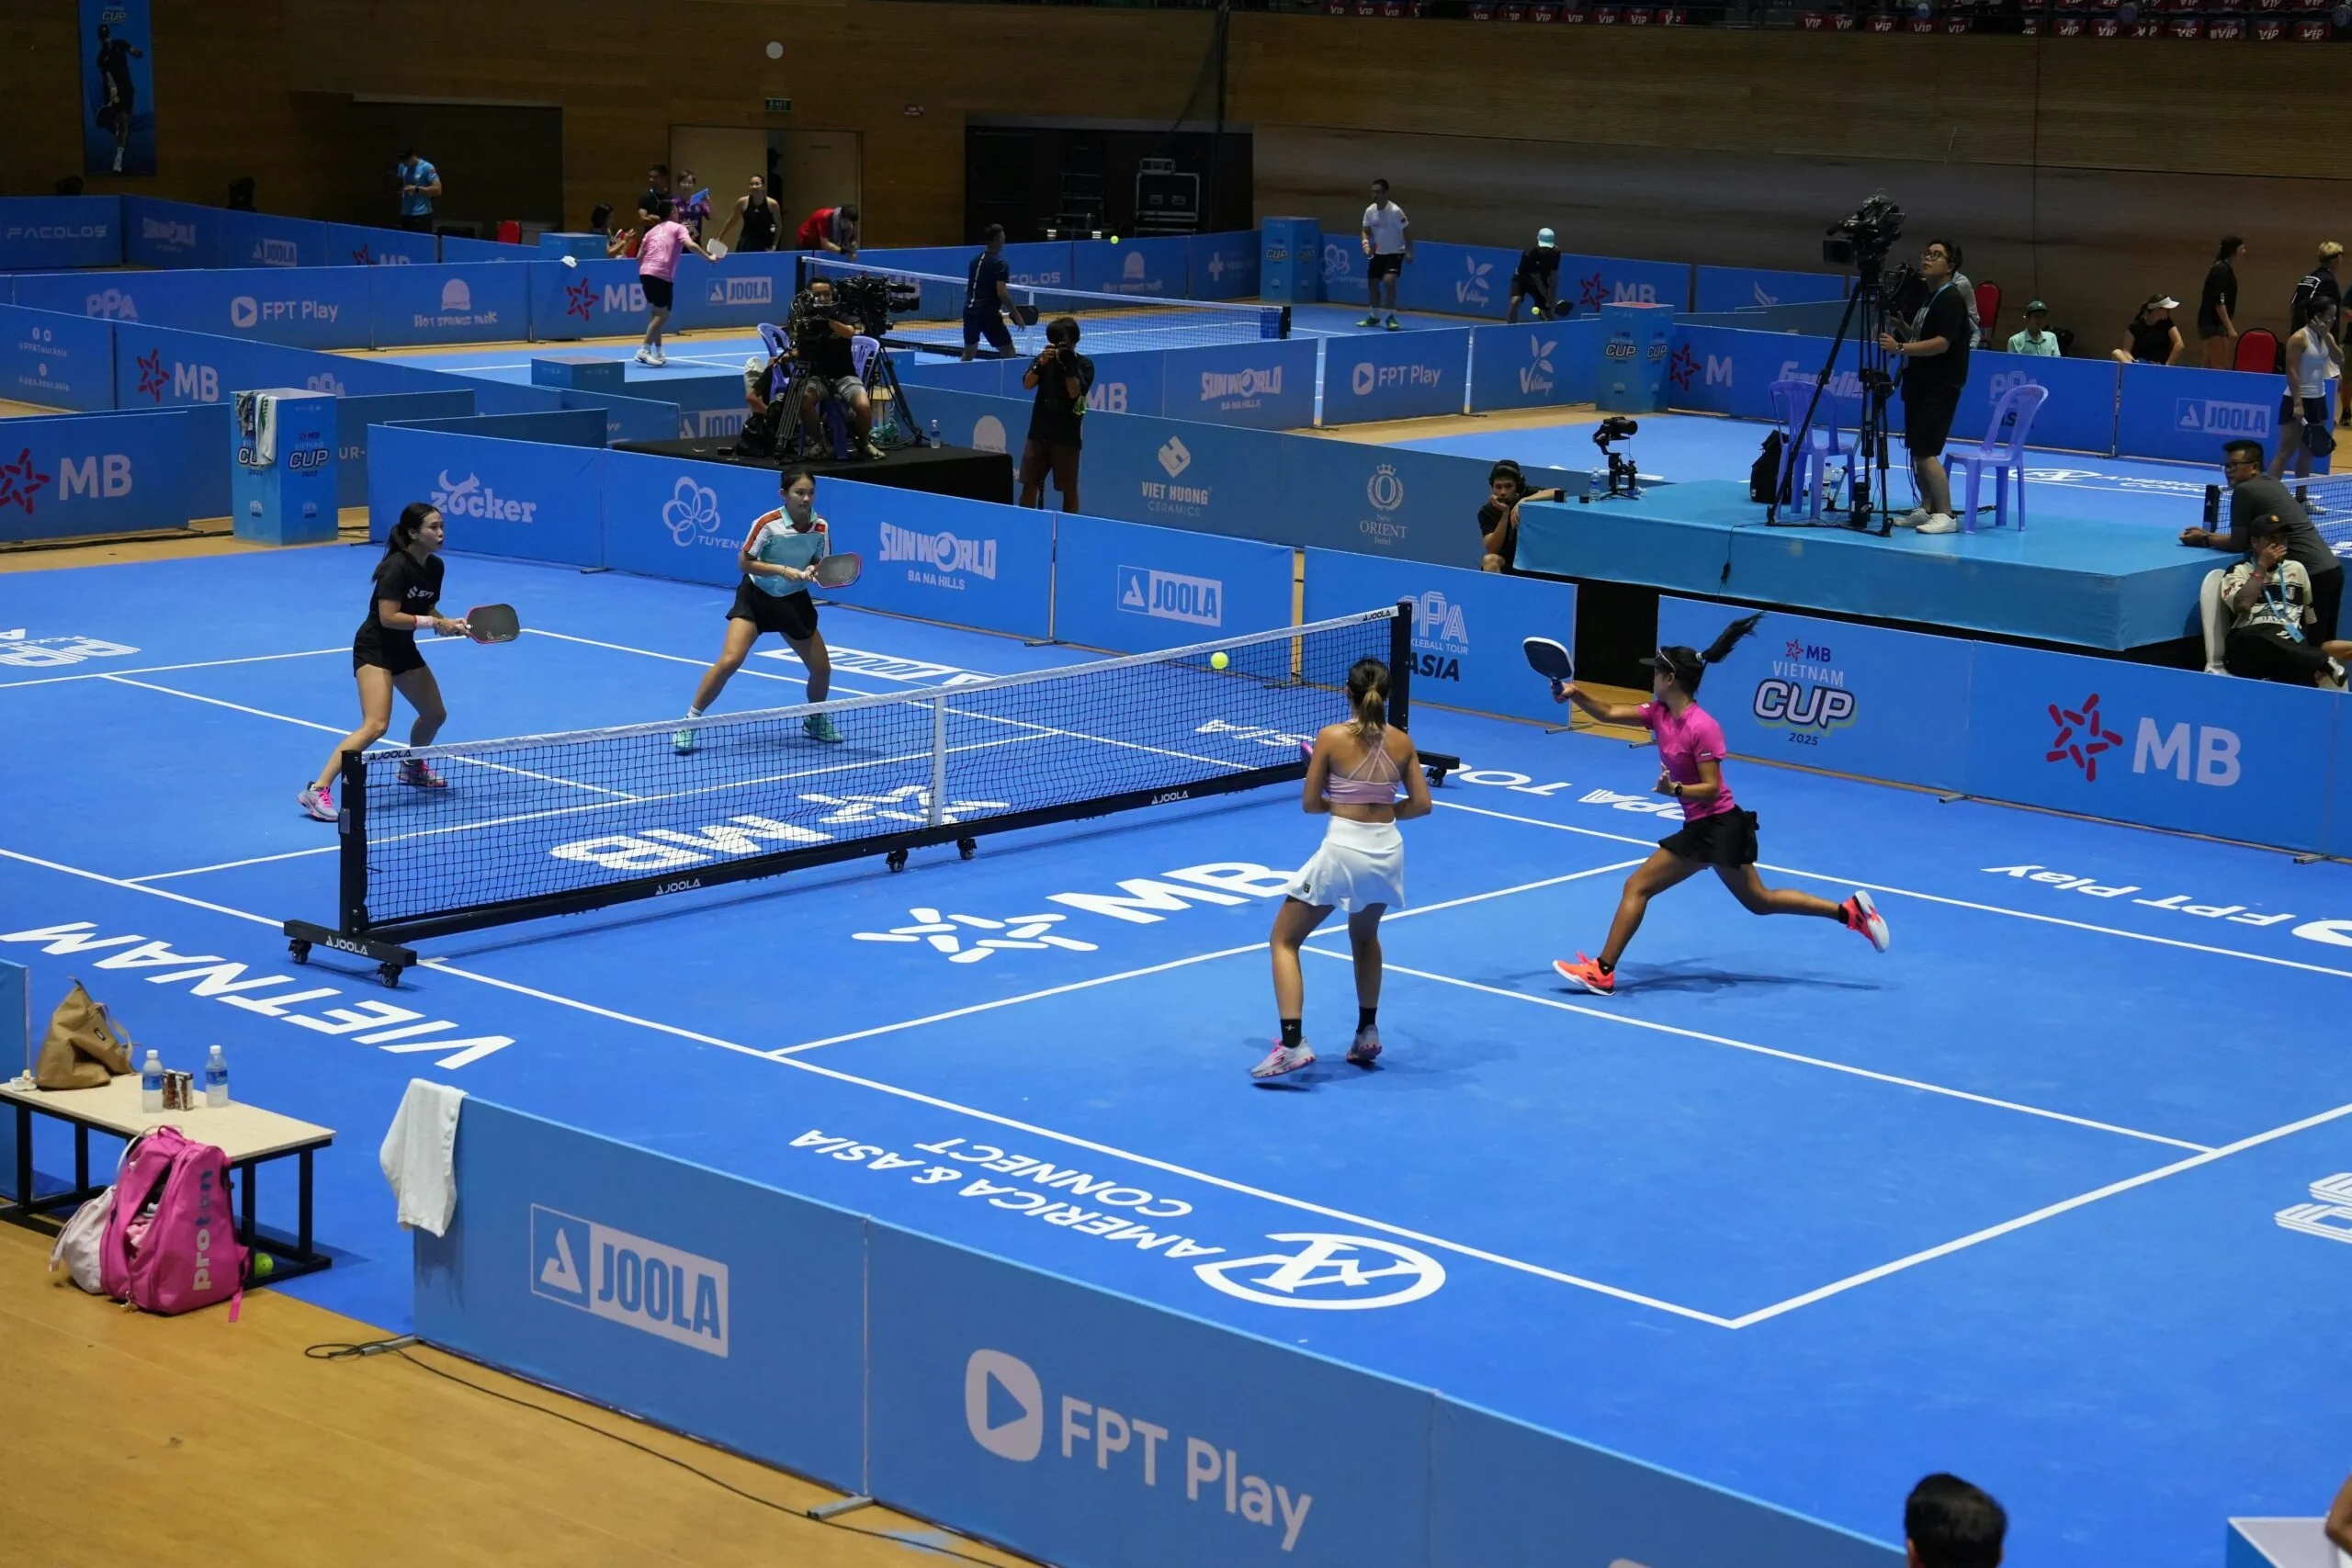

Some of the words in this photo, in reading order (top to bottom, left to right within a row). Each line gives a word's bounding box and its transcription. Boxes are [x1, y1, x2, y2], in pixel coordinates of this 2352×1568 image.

[1330, 6, 1343, 14] VIP
[1359, 7, 1374, 16] VIP
[1385, 8, 1399, 17] VIP
[1535, 13, 1551, 22] VIP
[1567, 14, 1583, 23] VIP
[1599, 15, 1614, 24] VIP
[1631, 15, 1647, 25] VIP
[1805, 18, 1822, 28] VIP
[1837, 19, 1852, 29] VIP
[1874, 21, 1892, 31] VIP
[1914, 23, 1932, 33] VIP
[1949, 24, 1965, 34] VIP
[2060, 26, 2079, 36] VIP
[2098, 27, 2117, 37] VIP
[2177, 28, 2197, 38] VIP
[2217, 28, 2238, 39] VIP
[2258, 29, 2279, 39] VIP
[2303, 29, 2324, 39] VIP
[7, 226, 107, 239] FACOLOS
[266, 243, 295, 263] JOOLA
[604, 283, 646, 312] MB
[730, 280, 771, 302] JOOLA
[263, 301, 296, 320] FPT
[301, 300, 339, 322] Play
[1605, 344, 1636, 357] CUP
[1646, 345, 1668, 358] CUP
[175, 361, 219, 402] MB
[1378, 366, 1404, 387] FPT
[1410, 365, 1441, 388] Play
[2209, 406, 2267, 434] JOOLA
[289, 449, 329, 469] CUP
[59, 454, 133, 501] MB
[1142, 481, 1166, 501] VIET
[1170, 484, 1208, 504] HUONG
[1148, 501, 1201, 517] CERAMICS
[1360, 520, 1408, 539] ORIENT
[908, 570, 921, 583] BA
[922, 572, 937, 586] NA
[938, 575, 965, 591] HILLS
[1152, 580, 1217, 619] JOOLA
[1367, 609, 1391, 620] JOOLA
[1446, 643, 1468, 655] TOUR
[1806, 645, 1831, 662] MB
[1409, 652, 1459, 682] ASIA
[1773, 660, 1844, 687] VIETNAM
[1753, 679, 1855, 729] CUP
[1789, 733, 1819, 746] 2025
[376, 750, 412, 760] JOOLA
[2133, 716, 2242, 787] MB
[1159, 790, 1189, 804] JOOLA
[549, 815, 835, 871] MB
[663, 877, 701, 892] JOOLA
[1980, 864, 2142, 898] Play
[1045, 862, 1298, 924] MB
[2132, 895, 2297, 927] FPT
[334, 938, 368, 956] JOOLA
[0, 921, 515, 1069] VIETNAM
[788, 1129, 926, 1171] ASIA
[910, 1166, 963, 1185] &
[913, 1138, 1193, 1218] CONNECT
[958, 1178, 1227, 1258] AMERICA
[194, 1169, 214, 1291] proton
[598, 1242, 721, 1340] JOOLA
[1061, 1394, 1168, 1486] FPT
[1186, 1437, 1313, 1552] Play
